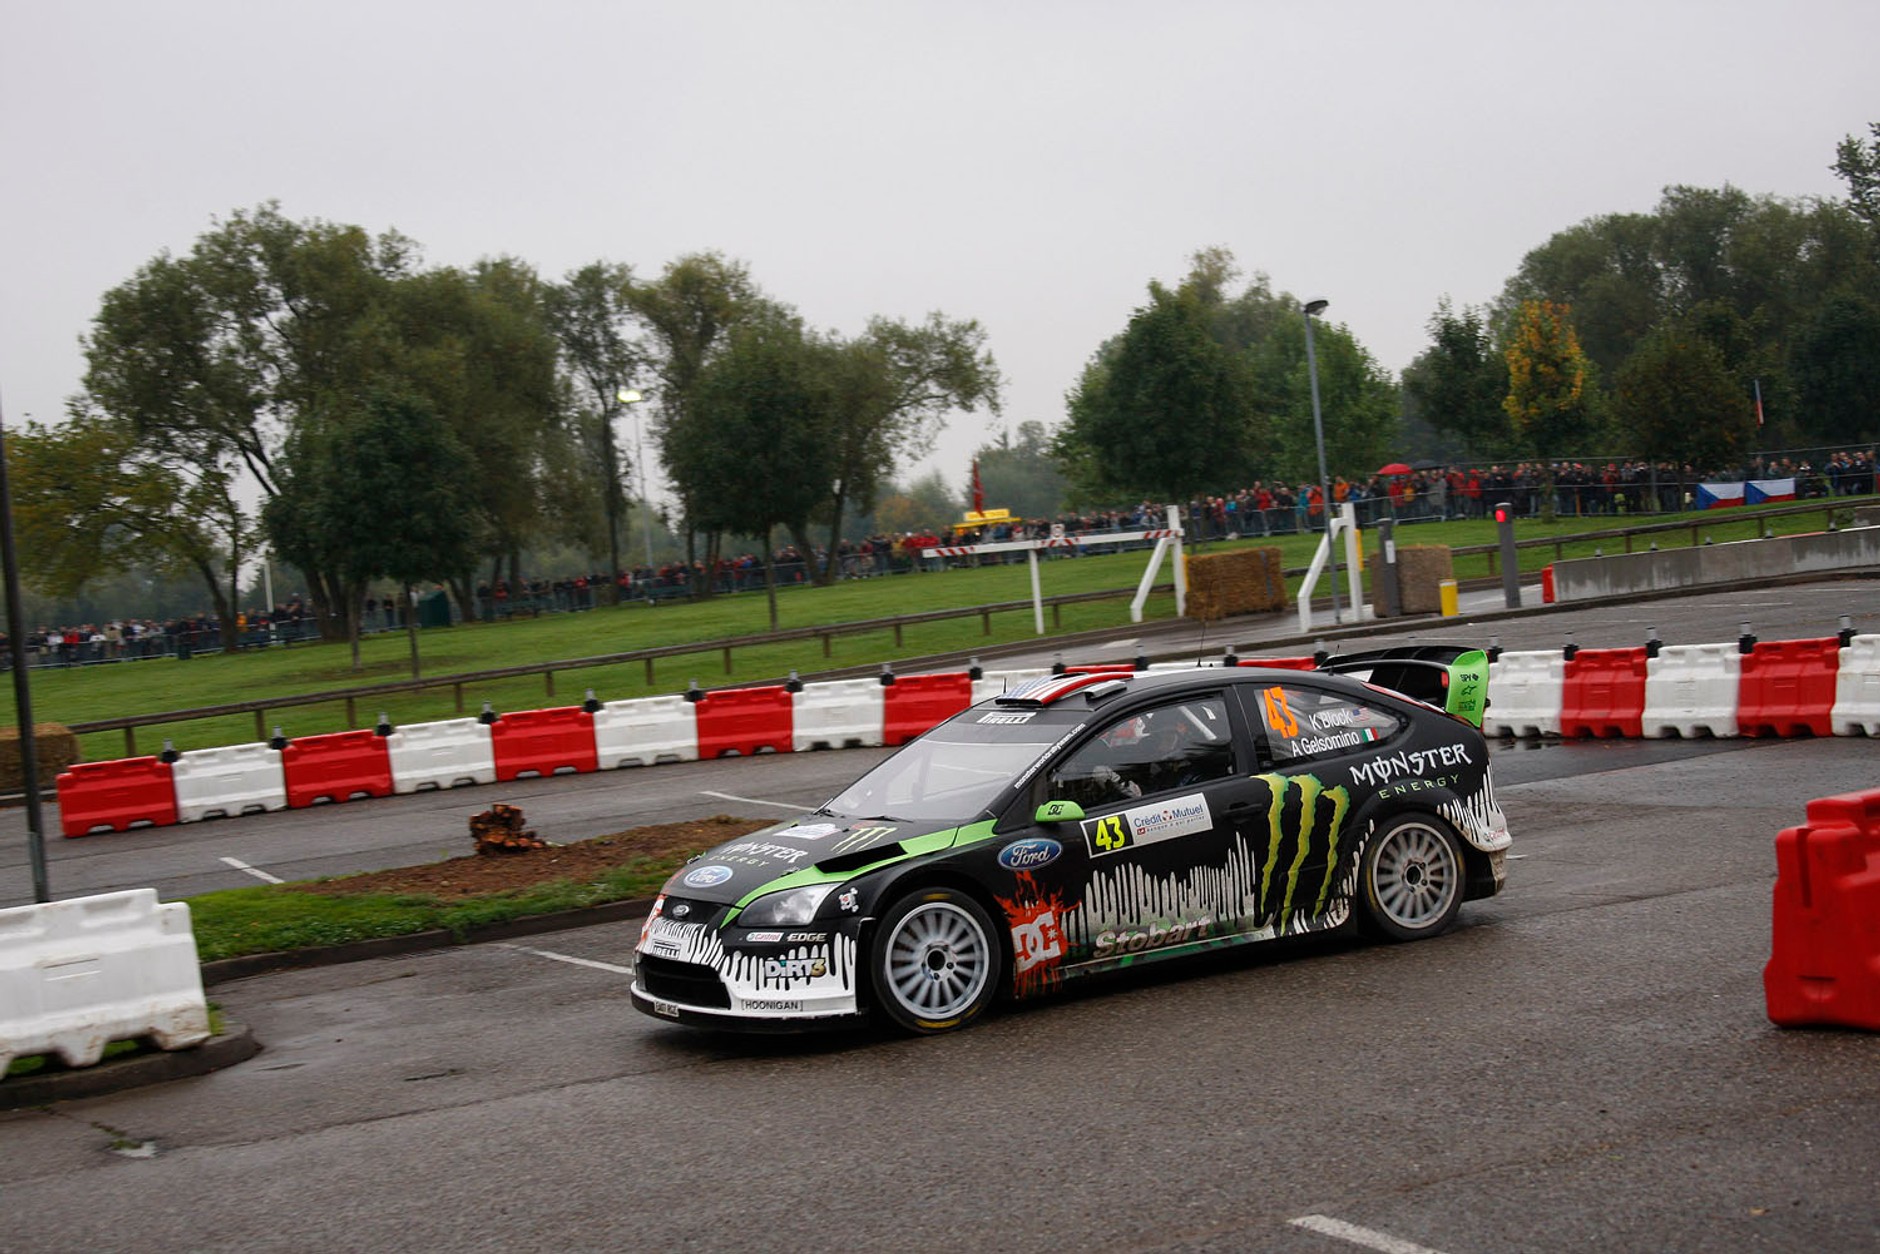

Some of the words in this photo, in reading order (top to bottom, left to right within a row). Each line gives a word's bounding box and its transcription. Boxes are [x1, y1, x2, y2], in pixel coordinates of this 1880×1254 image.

[1263, 686, 1299, 739] 43
[1309, 714, 1321, 730] K
[1321, 708, 1354, 729] Block
[1291, 740, 1302, 757] A
[1301, 730, 1360, 755] Gelsomino
[1378, 774, 1459, 800] ENERGY
[1171, 804, 1203, 819] Mutuel
[1095, 815, 1125, 851] 43
[1009, 843, 1051, 867] Ford
[786, 933, 828, 942] EDGE
[1093, 915, 1211, 959] Stobart
